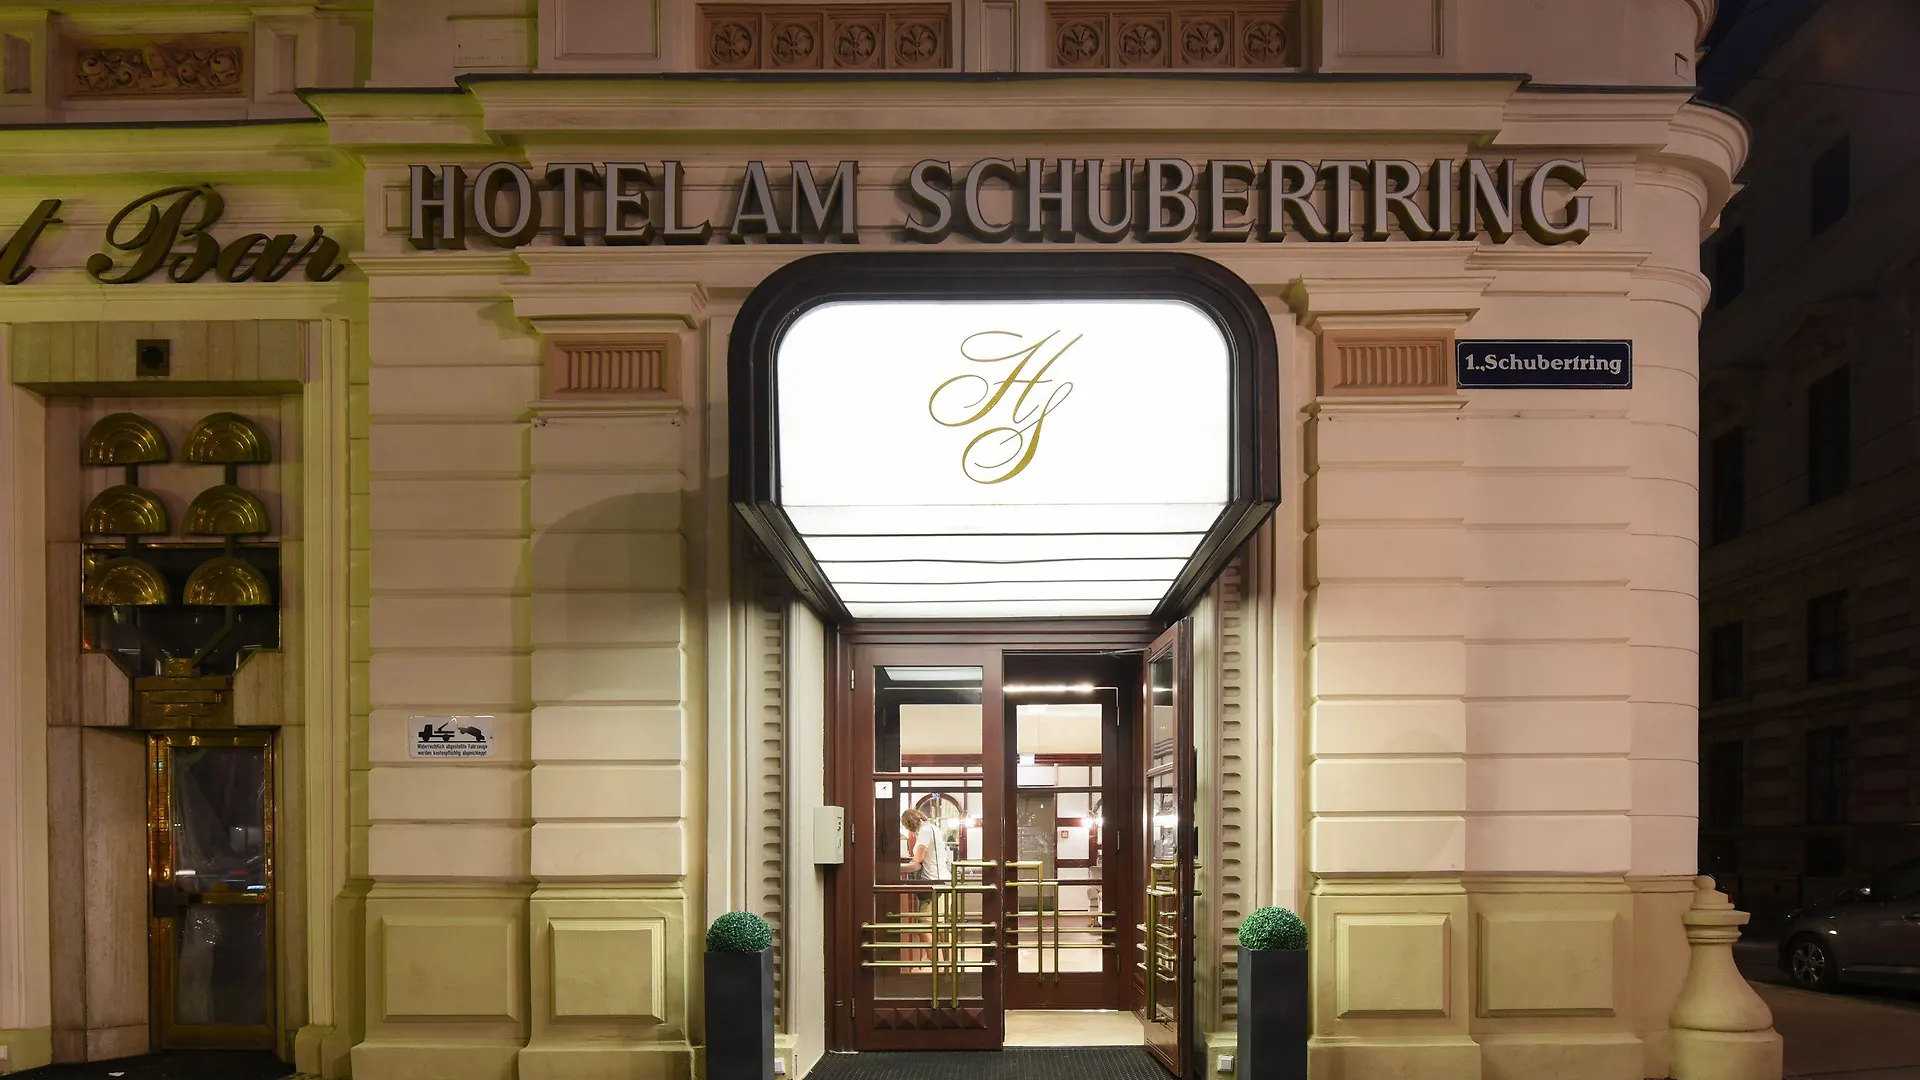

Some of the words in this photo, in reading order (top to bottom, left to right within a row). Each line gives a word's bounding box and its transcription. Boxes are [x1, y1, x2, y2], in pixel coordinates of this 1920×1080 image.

[87, 183, 345, 284] Bar
[408, 160, 713, 249] HOTEL
[727, 159, 861, 245] AM
[905, 157, 1594, 245] SCHUBERTRING
